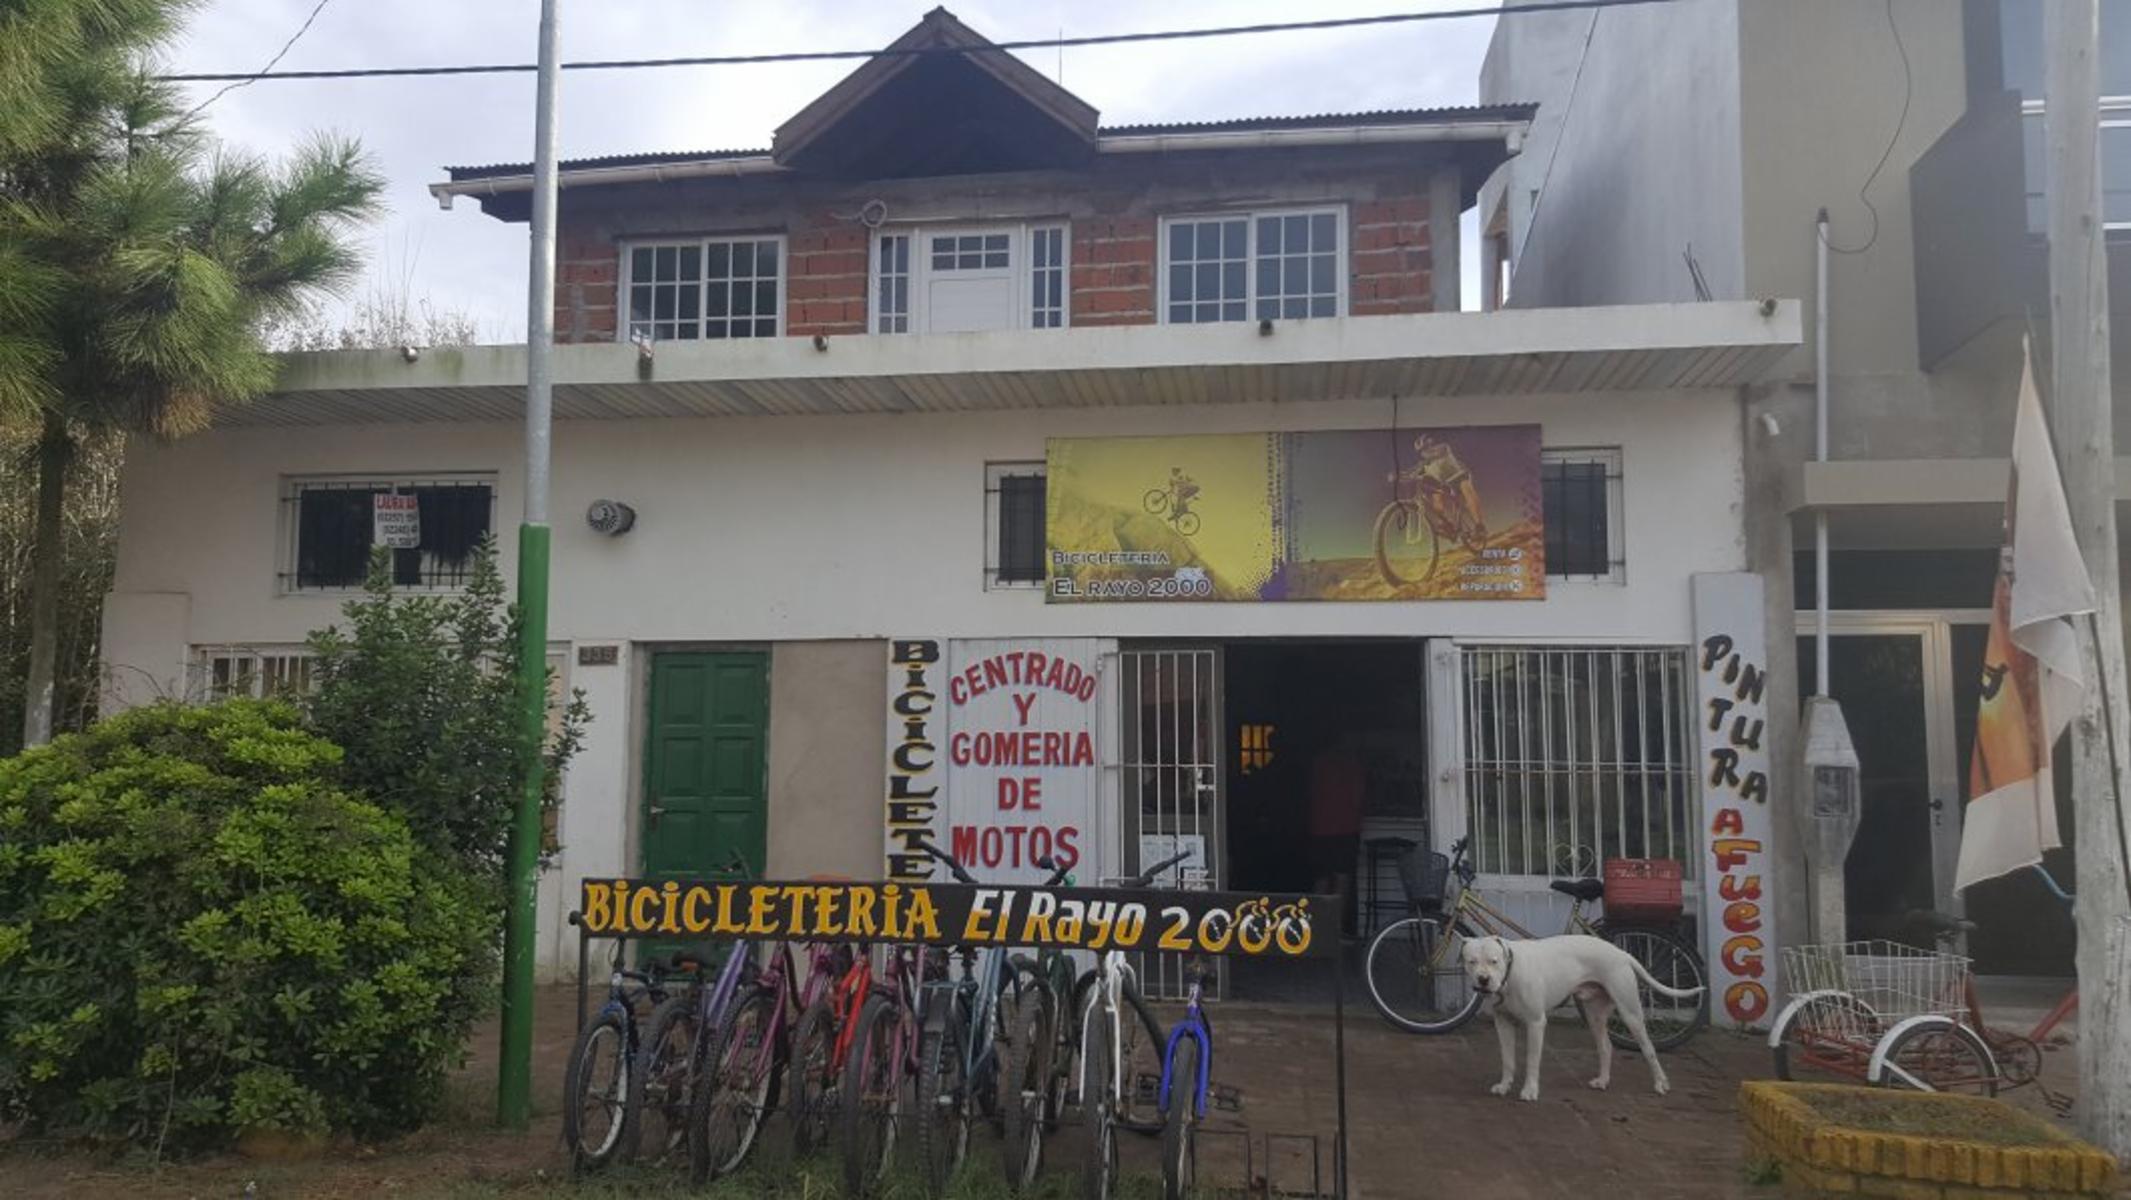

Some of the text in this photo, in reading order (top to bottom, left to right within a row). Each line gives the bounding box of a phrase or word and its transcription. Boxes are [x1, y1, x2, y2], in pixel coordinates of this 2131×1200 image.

[1053, 552, 1170, 565] BICICLETERIA
[1053, 578, 1213, 597] EL RAYO 2000
[950, 651, 1097, 706] CENTRADO
[1013, 692, 1037, 726] Y
[951, 731, 1095, 768] GOMERIA
[998, 776, 1042, 811] DE
[1711, 808, 1744, 837] A
[951, 825, 1080, 869] MOTOS
[583, 880, 1312, 954] BICICLETERIA El Rayo 2000
